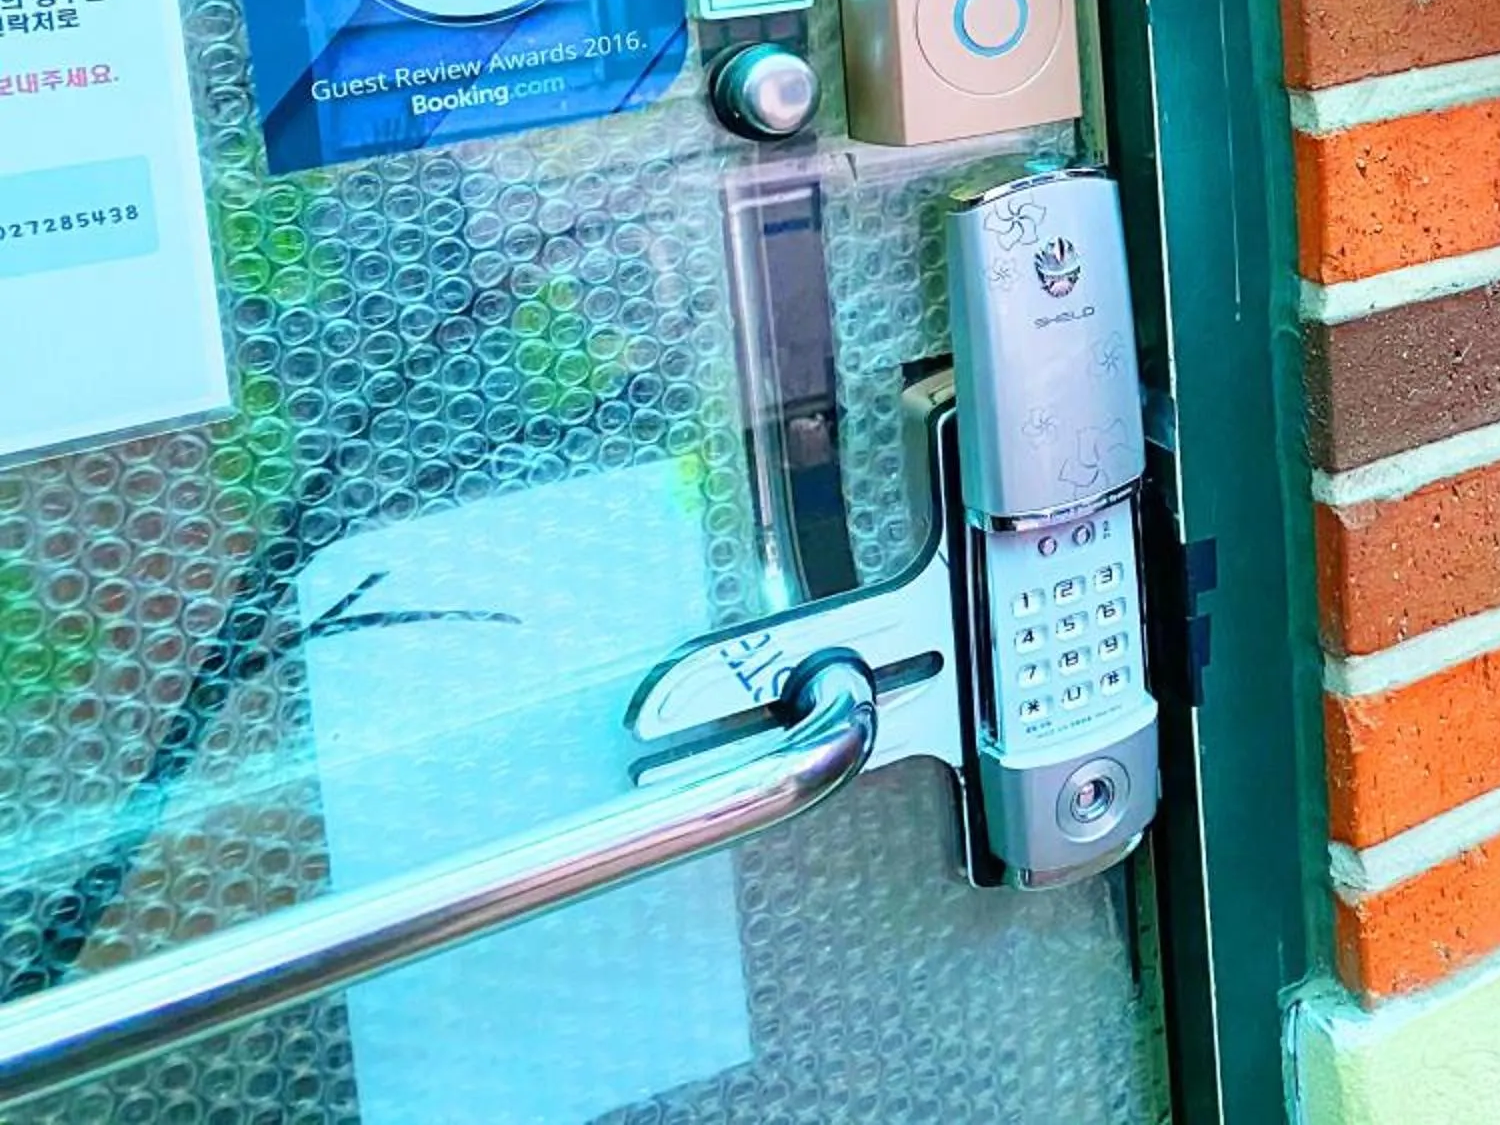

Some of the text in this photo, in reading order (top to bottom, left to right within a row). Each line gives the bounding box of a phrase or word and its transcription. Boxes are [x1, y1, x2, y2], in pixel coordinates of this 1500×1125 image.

[0, 8, 81, 37] 락처로
[311, 30, 648, 101] Guest Review Awards 2016.
[411, 75, 566, 116] Booking.com
